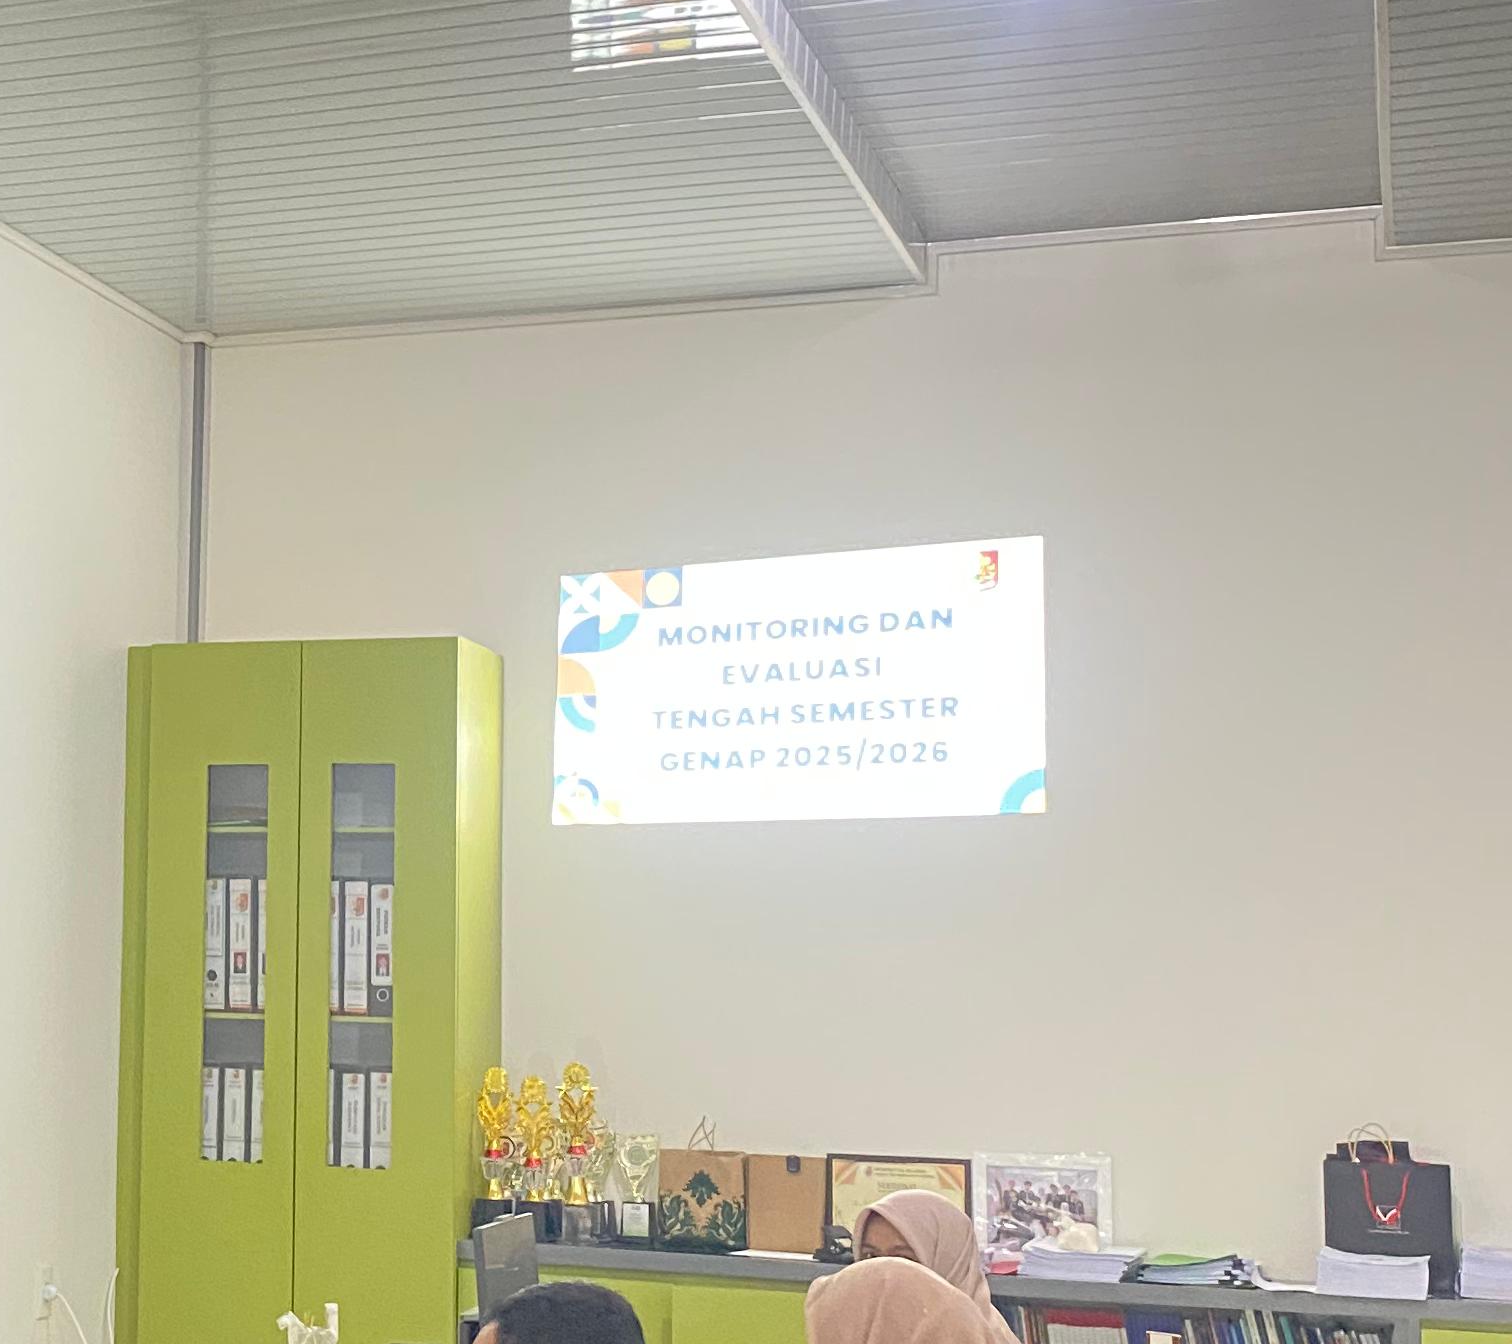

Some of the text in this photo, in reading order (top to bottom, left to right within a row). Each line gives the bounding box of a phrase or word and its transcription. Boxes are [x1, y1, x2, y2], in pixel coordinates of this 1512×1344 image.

[658, 607, 953, 647] MONITORING DAN
[722, 656, 882, 685] EVALUASI
[653, 697, 959, 730] TENGAH SEMESTER
[660, 737, 949, 772] GENAP 2025/2026
